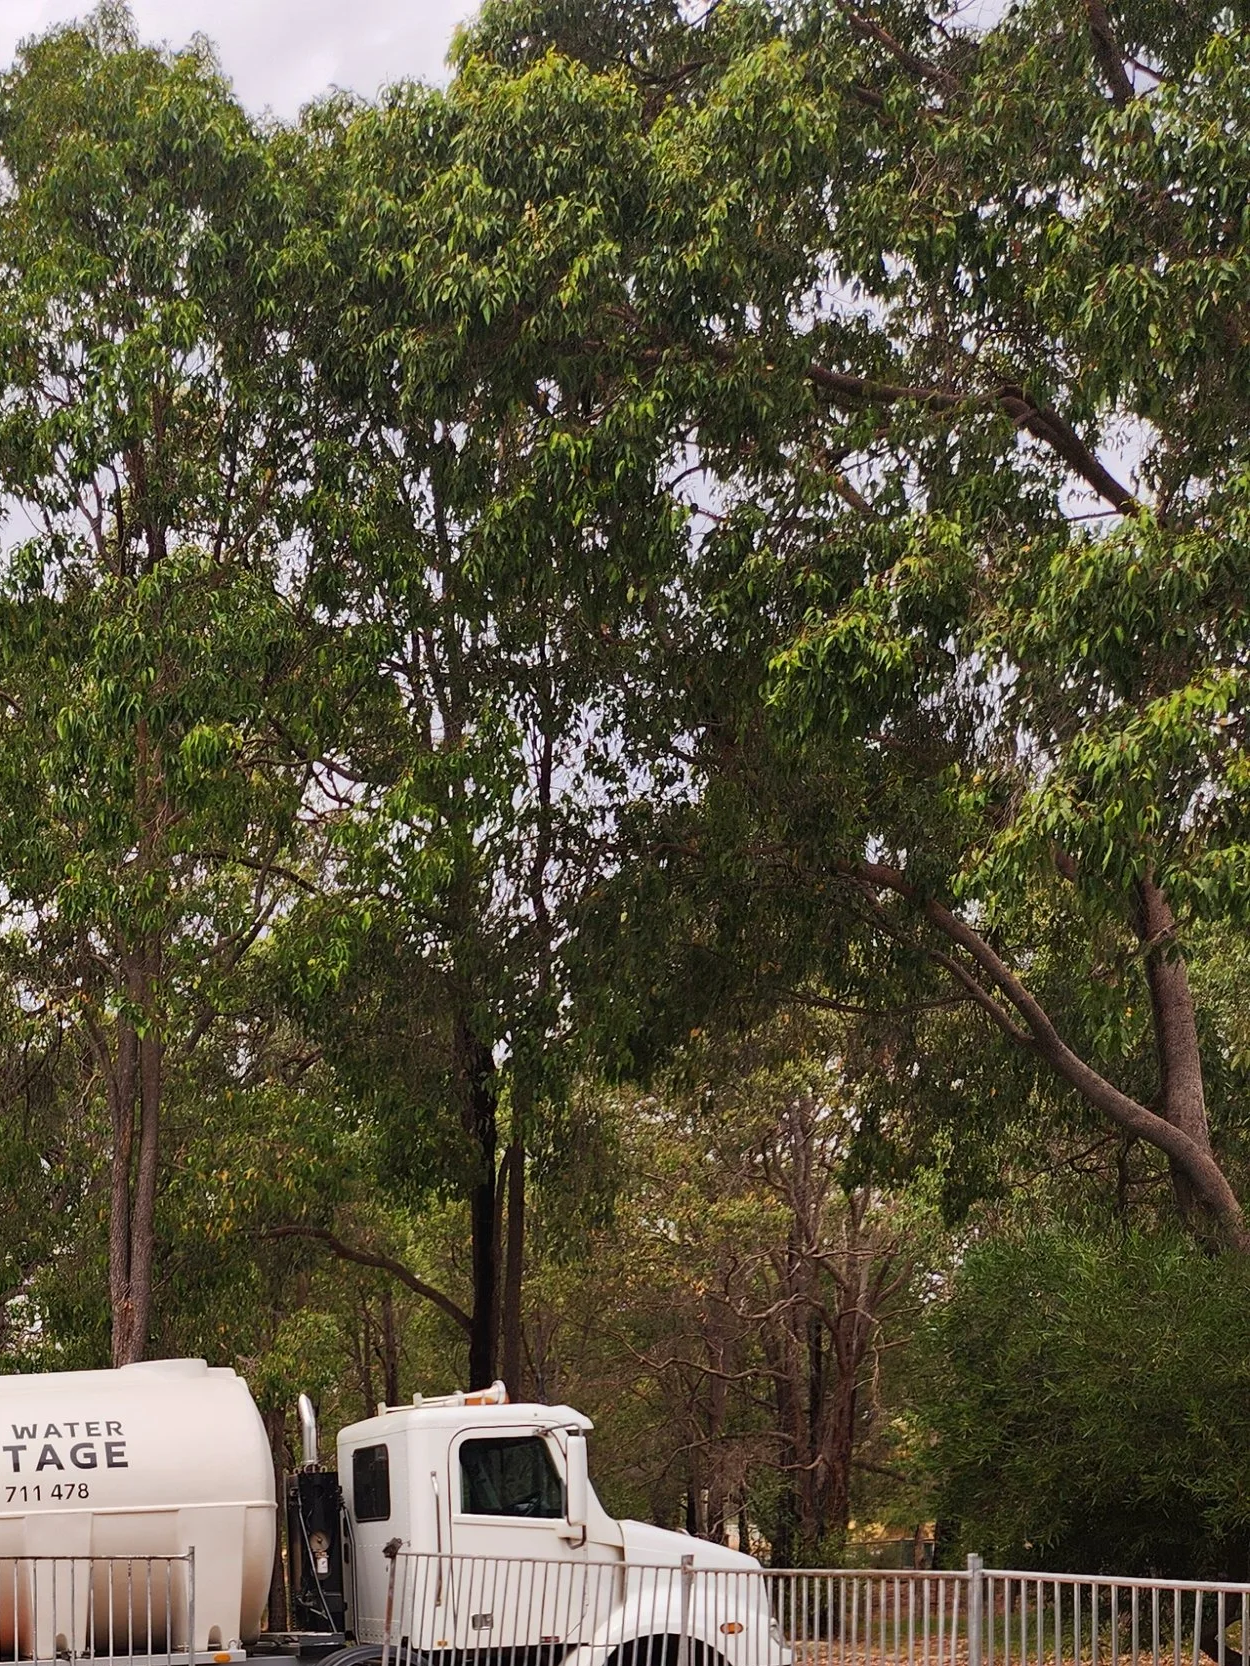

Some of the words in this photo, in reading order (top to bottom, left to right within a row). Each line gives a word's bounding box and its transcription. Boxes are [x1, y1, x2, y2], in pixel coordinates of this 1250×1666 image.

[11, 1420, 124, 1440] WATER
[5, 1485, 42, 1503] 711
[50, 1482, 90, 1501] 478
